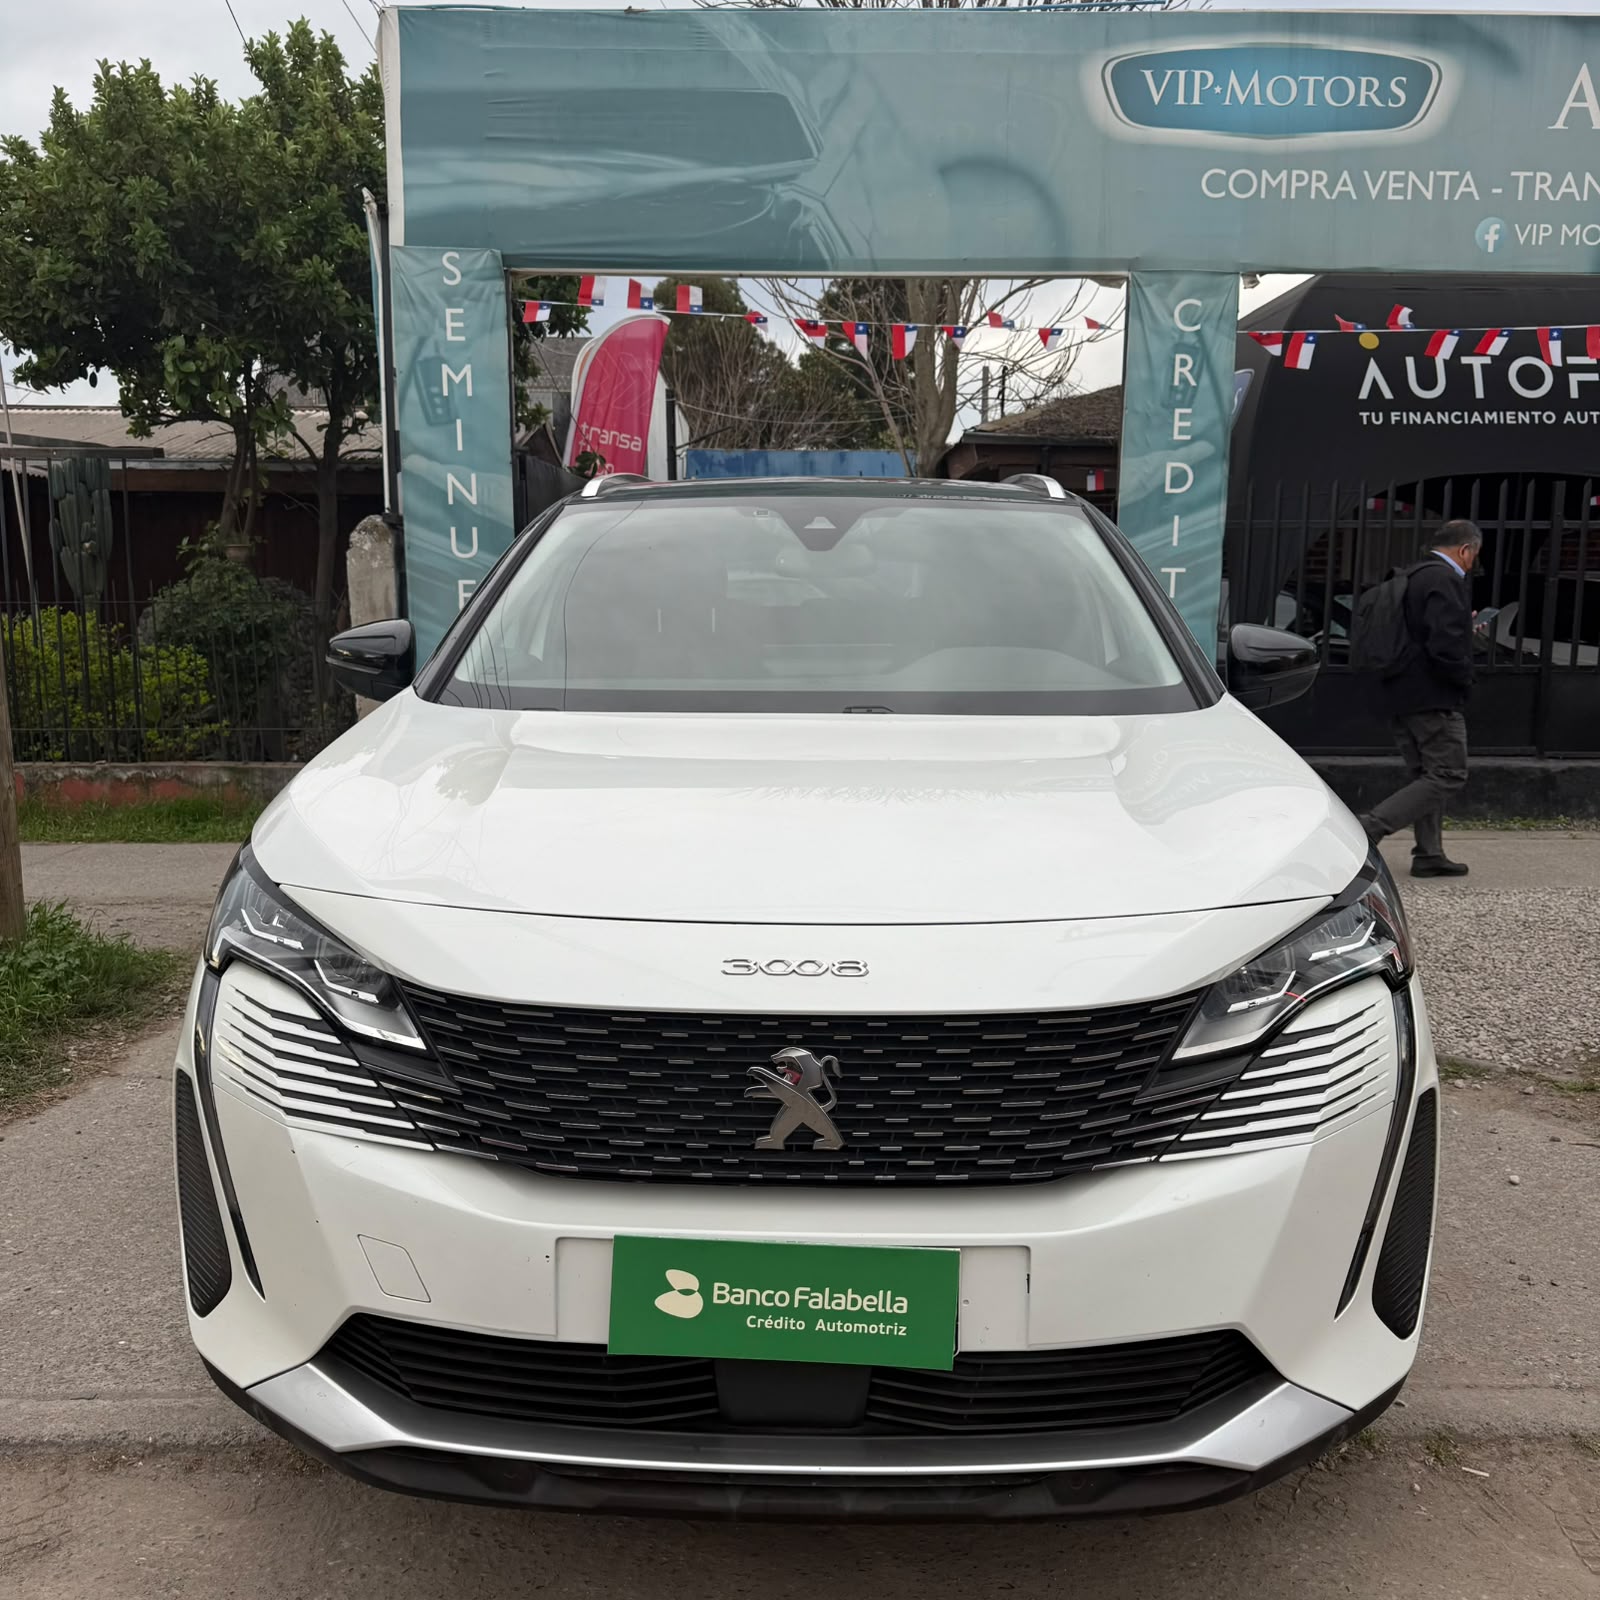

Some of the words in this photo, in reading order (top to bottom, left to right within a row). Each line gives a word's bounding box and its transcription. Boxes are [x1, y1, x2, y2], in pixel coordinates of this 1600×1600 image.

[1140, 69, 1214, 106] VIP
[1223, 69, 1408, 108] MOTORS
[1201, 168, 1357, 199] COMPRA
[1363, 170, 1480, 201] VENTA
[1514, 223, 1553, 246] VIP
[1560, 223, 1600, 246] MO
[1358, 356, 1600, 399] AUTOF
[1359, 412, 1384, 425] TU
[1390, 411, 1556, 425] FINANCIAMIENTO
[1563, 411, 1600, 424] AUT
[581, 421, 643, 452] transa
[1160, 298, 1202, 599] CREDIT
[720, 958, 870, 978] 3008
[712, 1282, 791, 1308] Banco
[793, 1286, 909, 1314] Falabella
[746, 1315, 806, 1331] Crédito
[815, 1318, 908, 1336] Automotriz
